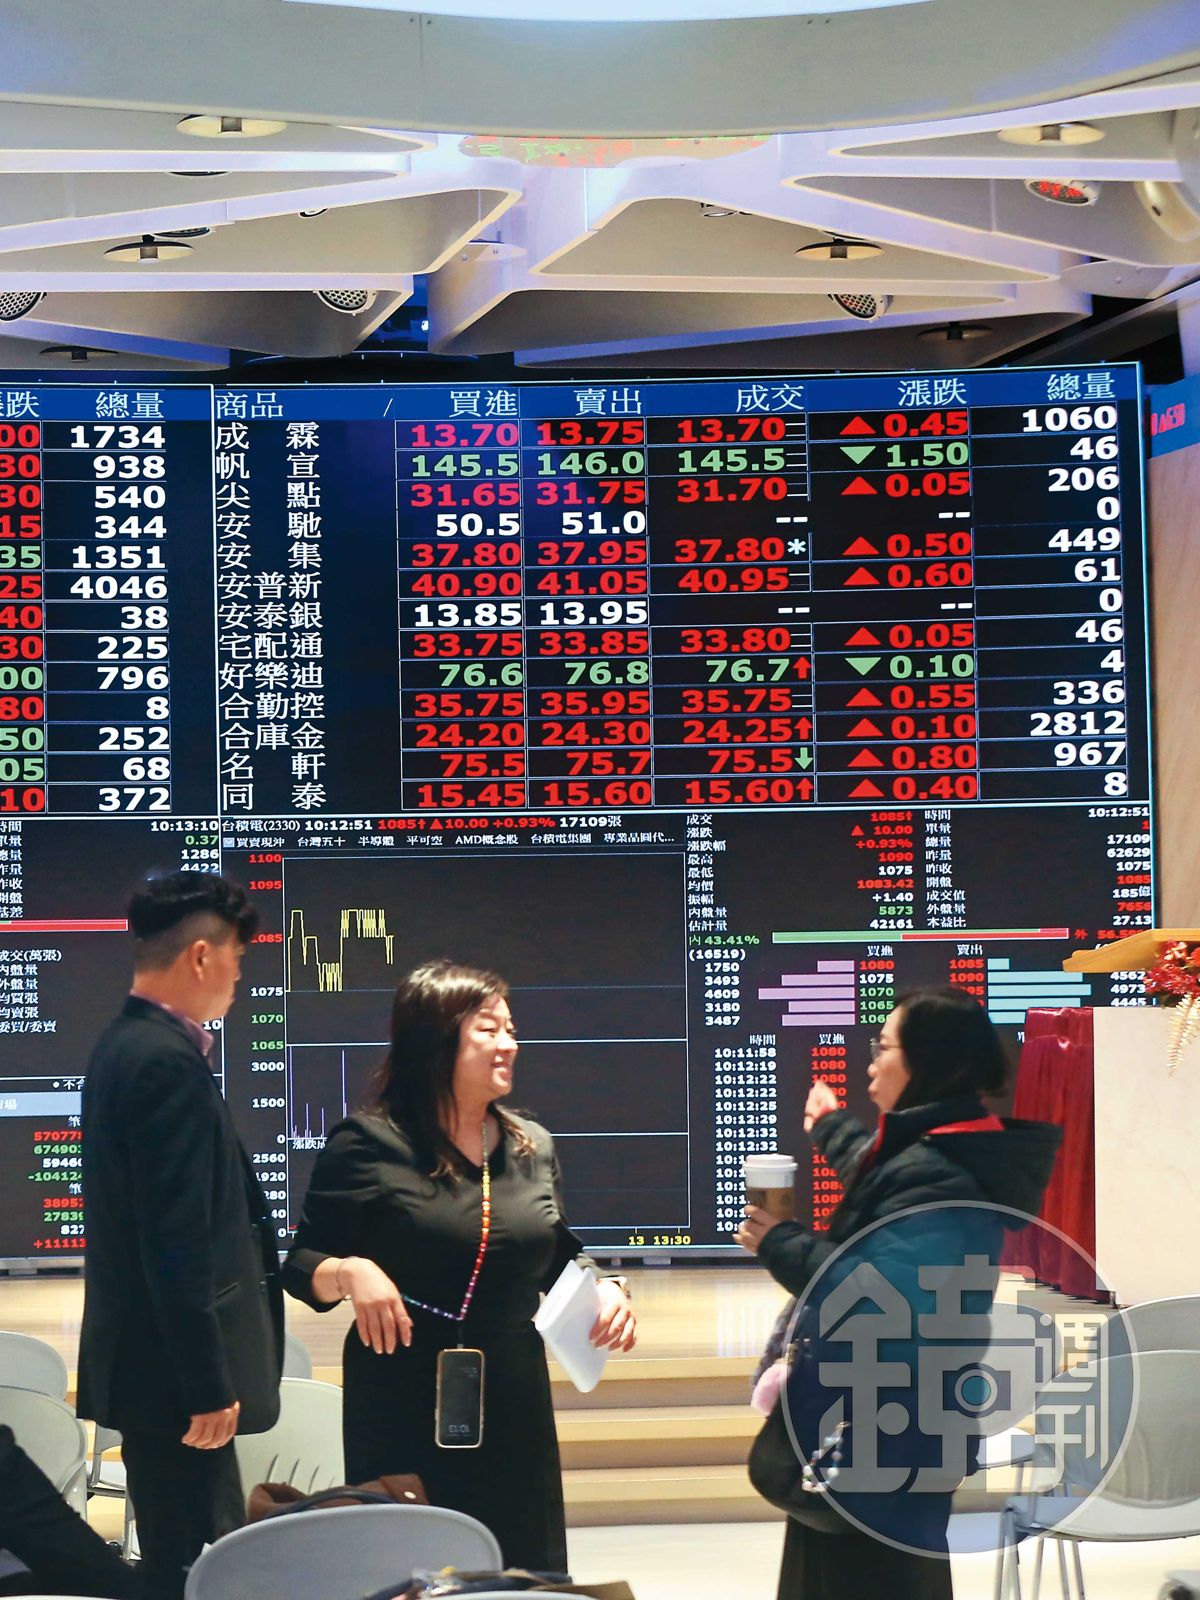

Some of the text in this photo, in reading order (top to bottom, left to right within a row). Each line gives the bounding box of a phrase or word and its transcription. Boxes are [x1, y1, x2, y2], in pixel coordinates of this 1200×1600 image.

[96, 391, 164, 419] 總量
[216, 373, 1116, 419] 商品 買進 賣出 成交 漲跌 總量
[411, 406, 1117, 446] 13.70 13.75 13.70 0.45 1060
[70, 426, 165, 449] 1734
[412, 436, 1118, 476] 145.5 146.0 145.5 1.50 46
[95, 486, 165, 509] 540
[72, 546, 165, 568] 1351
[218, 558, 1120, 599] 安普新 40.90 41.05 40.95 0.60 61
[219, 589, 1122, 629] 安泰銀 13.85 13.95 0
[97, 637, 167, 659] 225
[97, 667, 168, 689] 796
[219, 650, 1124, 689] 好樂迪 76.6 76.8 76.7 0.10 4
[219, 681, 1124, 720] 合勤控 35.75 35.95 35.75 0.55 336
[99, 728, 169, 751] 252
[219, 711, 1125, 750] 合庫金 24.20 24.30 24.25 0.10 2812
[99, 788, 170, 811] 372
[418, 772, 1126, 806] 15.45 15.60 15.60 0.40 8
[222, 816, 622, 832] 台積電(2330) 10:12:51 1085 10.00 +0.93% 17109張
[1089, 808, 1149, 818] 10:12:51
[151, 821, 218, 832] 10:13:10
[1108, 835, 1150, 844] 17109
[250, 854, 281, 863] 1100
[879, 866, 912, 875] 1075
[870, 919, 913, 929] 42161
[689, 949, 745, 961] (16519)
[705, 961, 895, 972] 1750 1080
[1110, 972, 1145, 981] 4562
[705, 974, 893, 985] 3493 1075
[1111, 985, 1145, 994] 4973
[251, 987, 284, 996] 1075
[715, 1048, 776, 1058] 10:11:58
[715, 1102, 777, 1111] 10:12:25
[716, 1128, 777, 1138] 10:12:32
